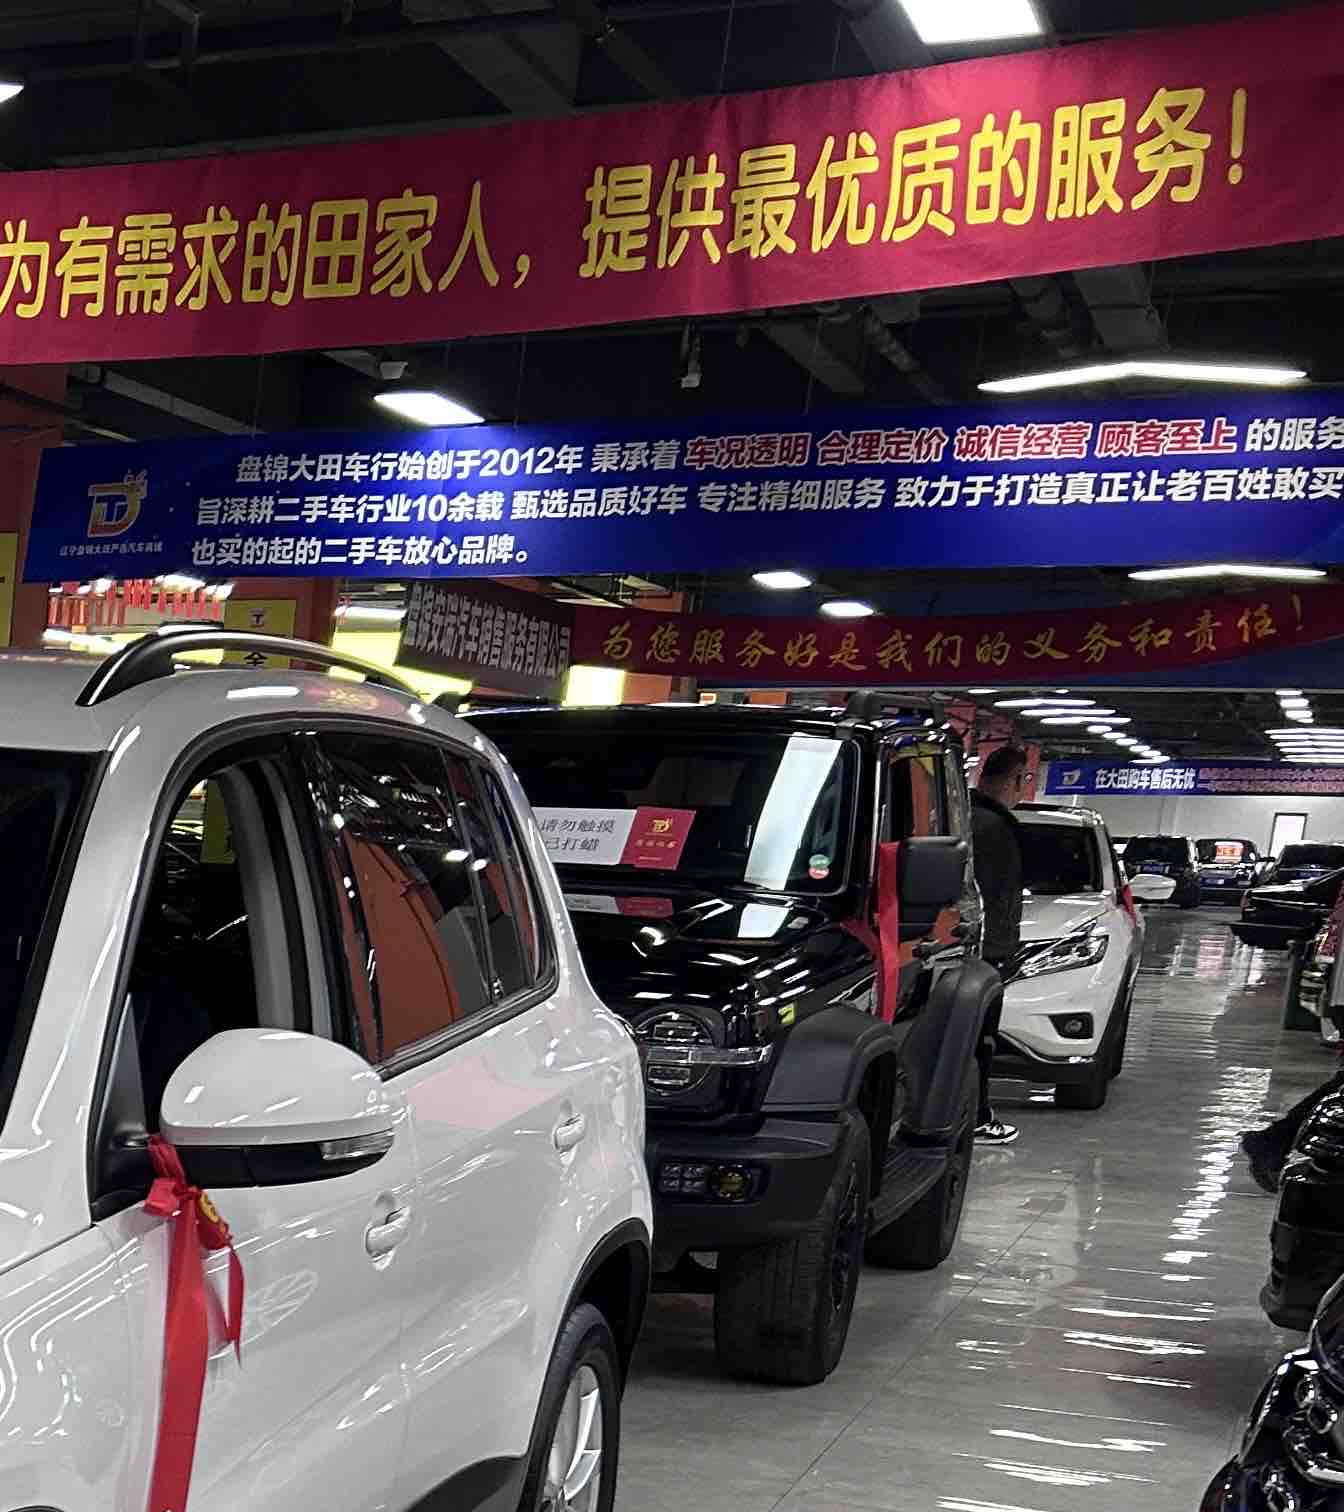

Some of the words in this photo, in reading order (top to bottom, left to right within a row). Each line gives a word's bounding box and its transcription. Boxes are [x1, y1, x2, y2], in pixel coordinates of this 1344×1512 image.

[683, 432, 812, 470] 车况透明
[816, 427, 947, 466] 合理定价
[954, 422, 1091, 462] 诚信经营
[1095, 417, 1237, 458] 顾客至上
[1245, 415, 1344, 452] 的服务
[697, 477, 887, 514] 专注精细服务
